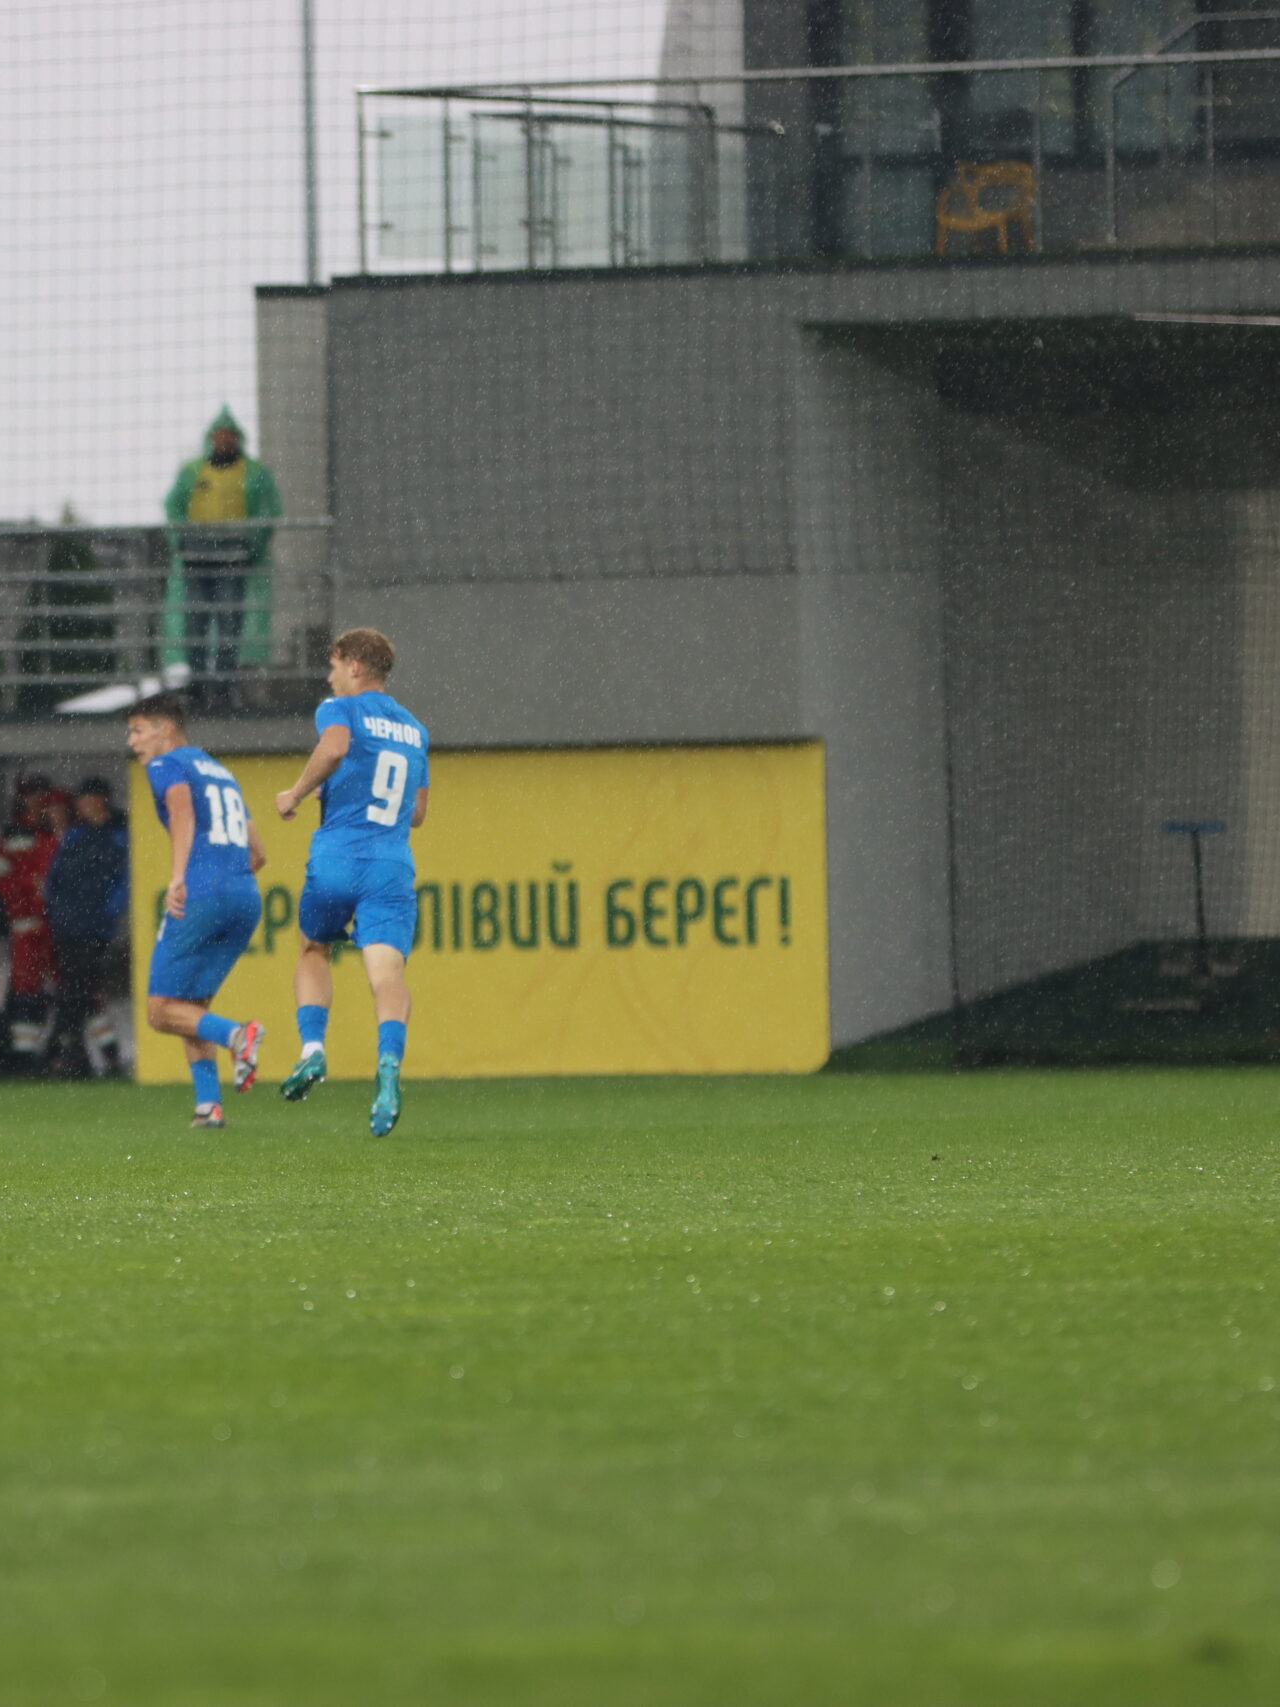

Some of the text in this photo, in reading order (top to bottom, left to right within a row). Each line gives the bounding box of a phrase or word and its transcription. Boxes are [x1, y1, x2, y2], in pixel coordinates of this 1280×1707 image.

[363, 716, 422, 749] ЧЕРНОВ
[204, 783, 248, 848] 18
[366, 750, 409, 827] 9
[606, 874, 792, 949] БЕРЕГ!
